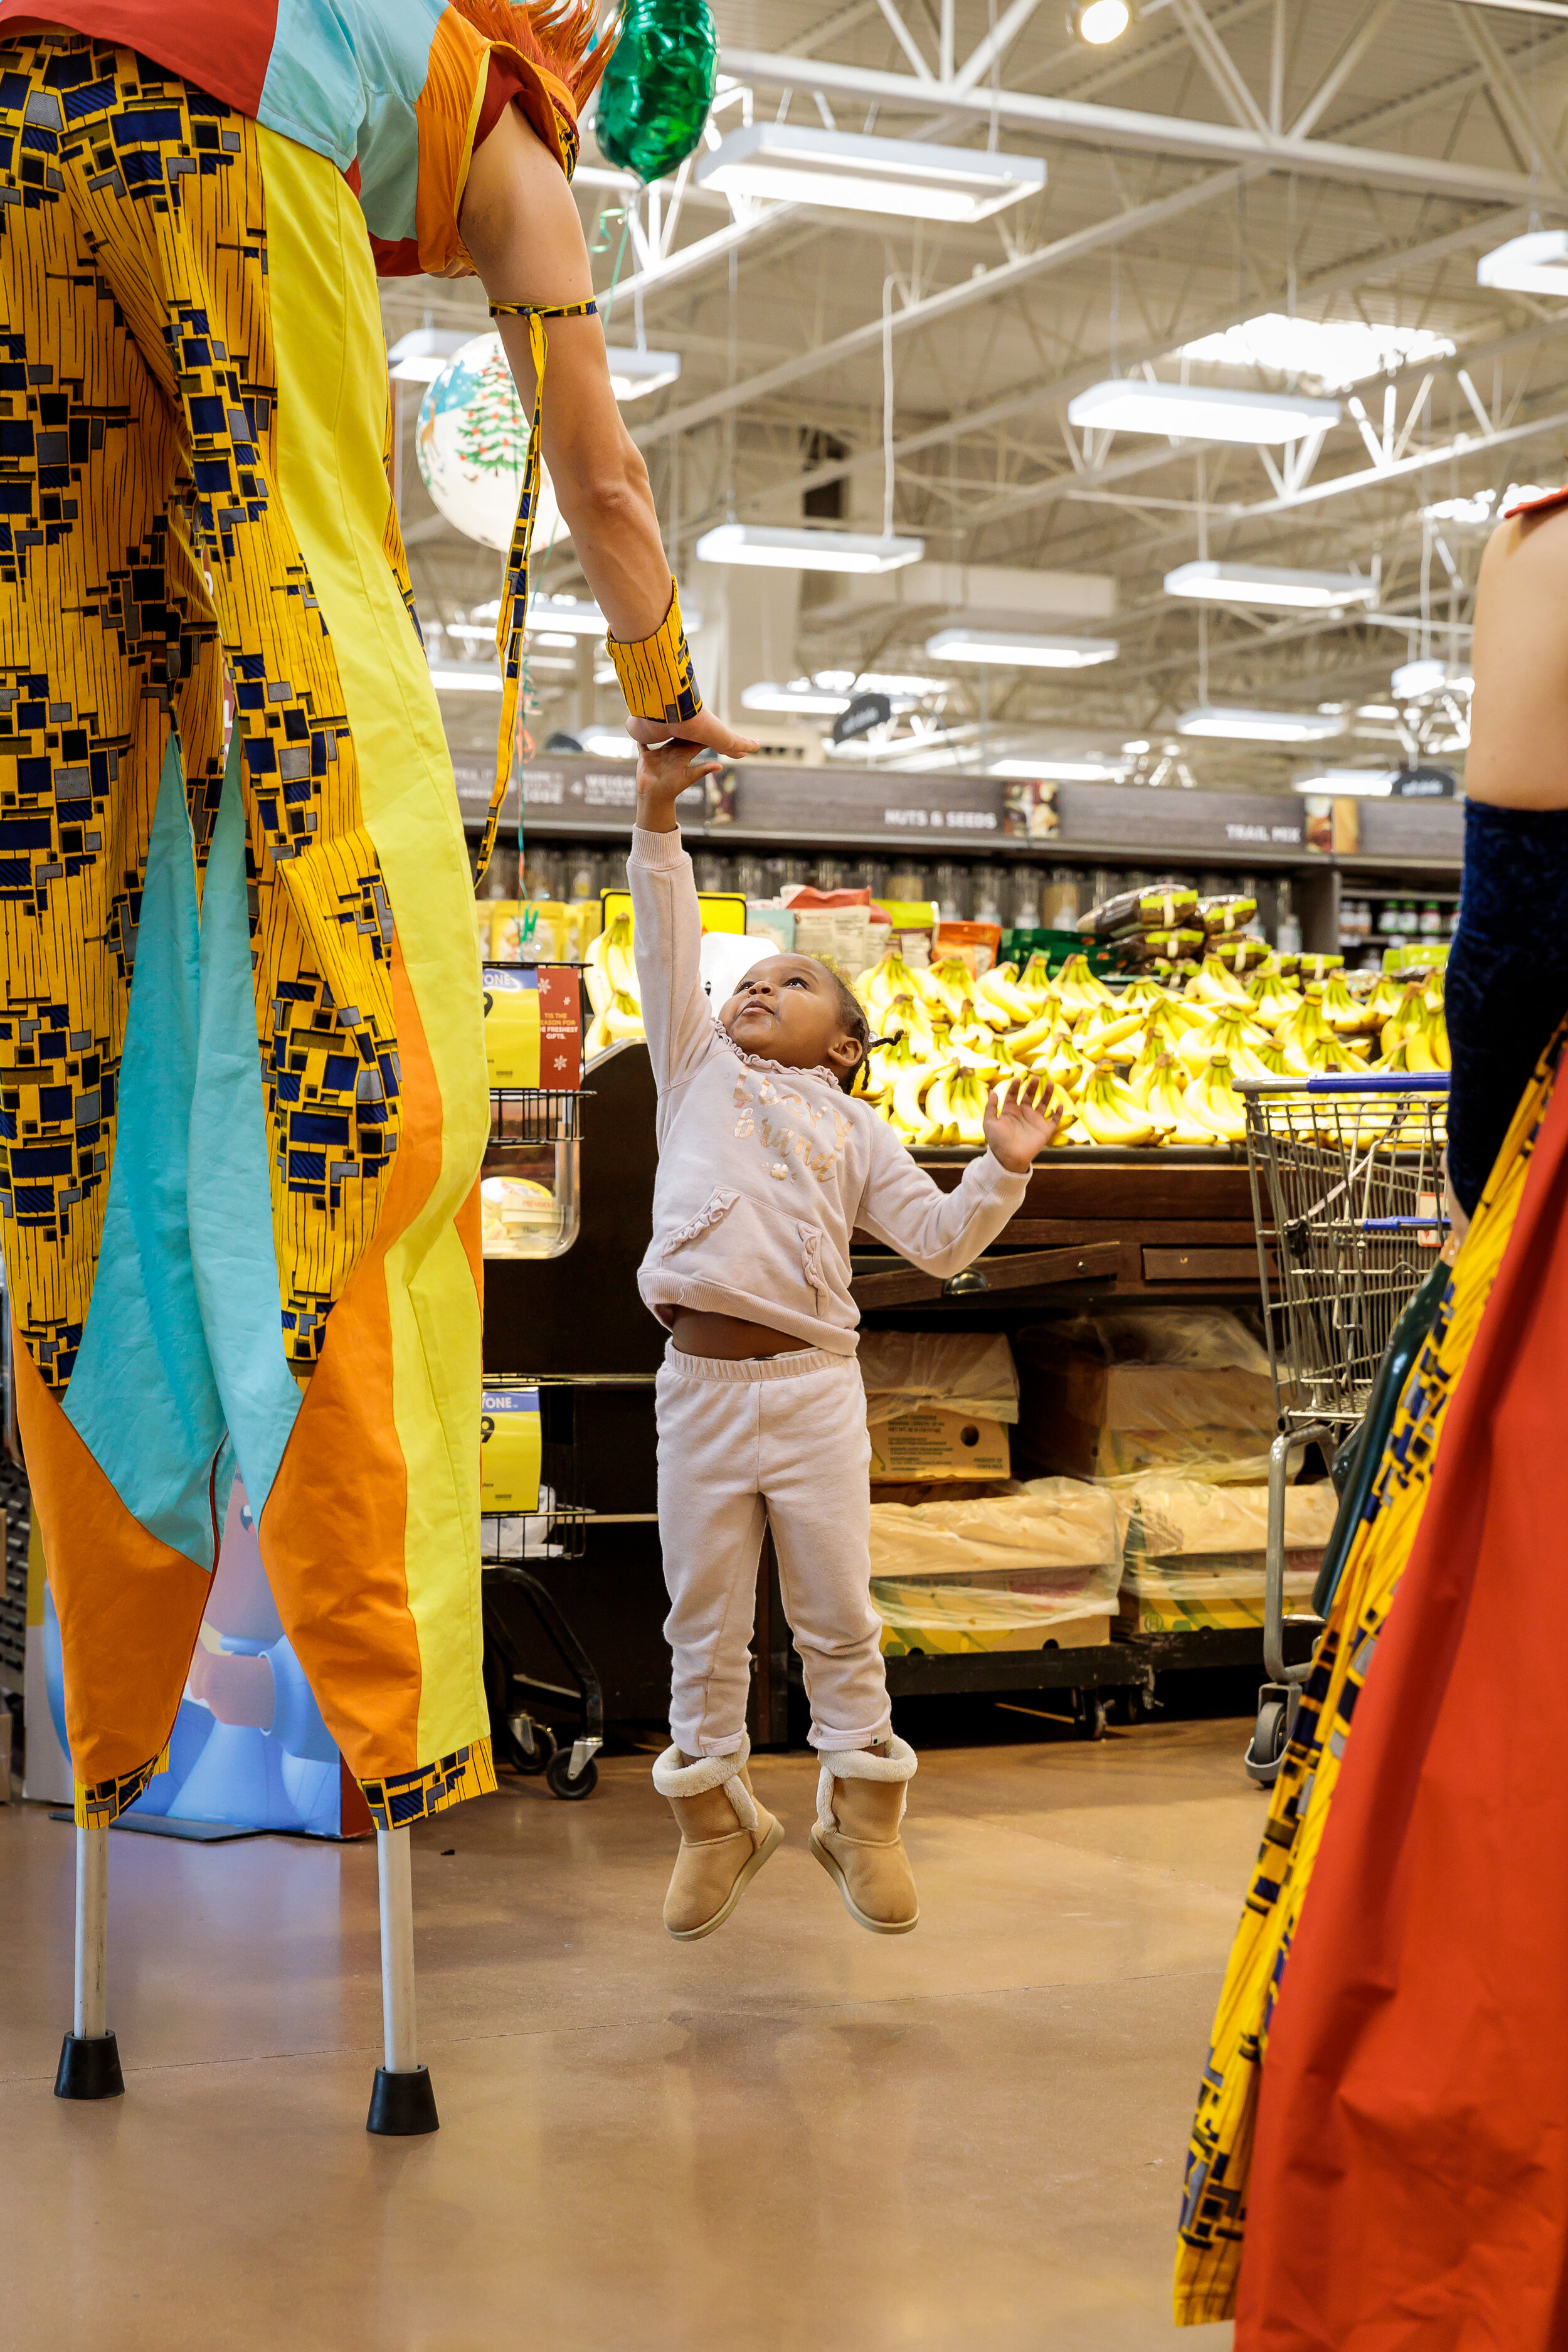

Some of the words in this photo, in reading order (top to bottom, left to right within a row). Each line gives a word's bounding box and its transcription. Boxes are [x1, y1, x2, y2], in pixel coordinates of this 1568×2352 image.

[884, 808, 928, 827] NUTS
[930, 810, 944, 828] &
[946, 810, 997, 830] SEEDS
[1226, 824, 1270, 842] TRAIL
[1271, 825, 1301, 844] MIX
